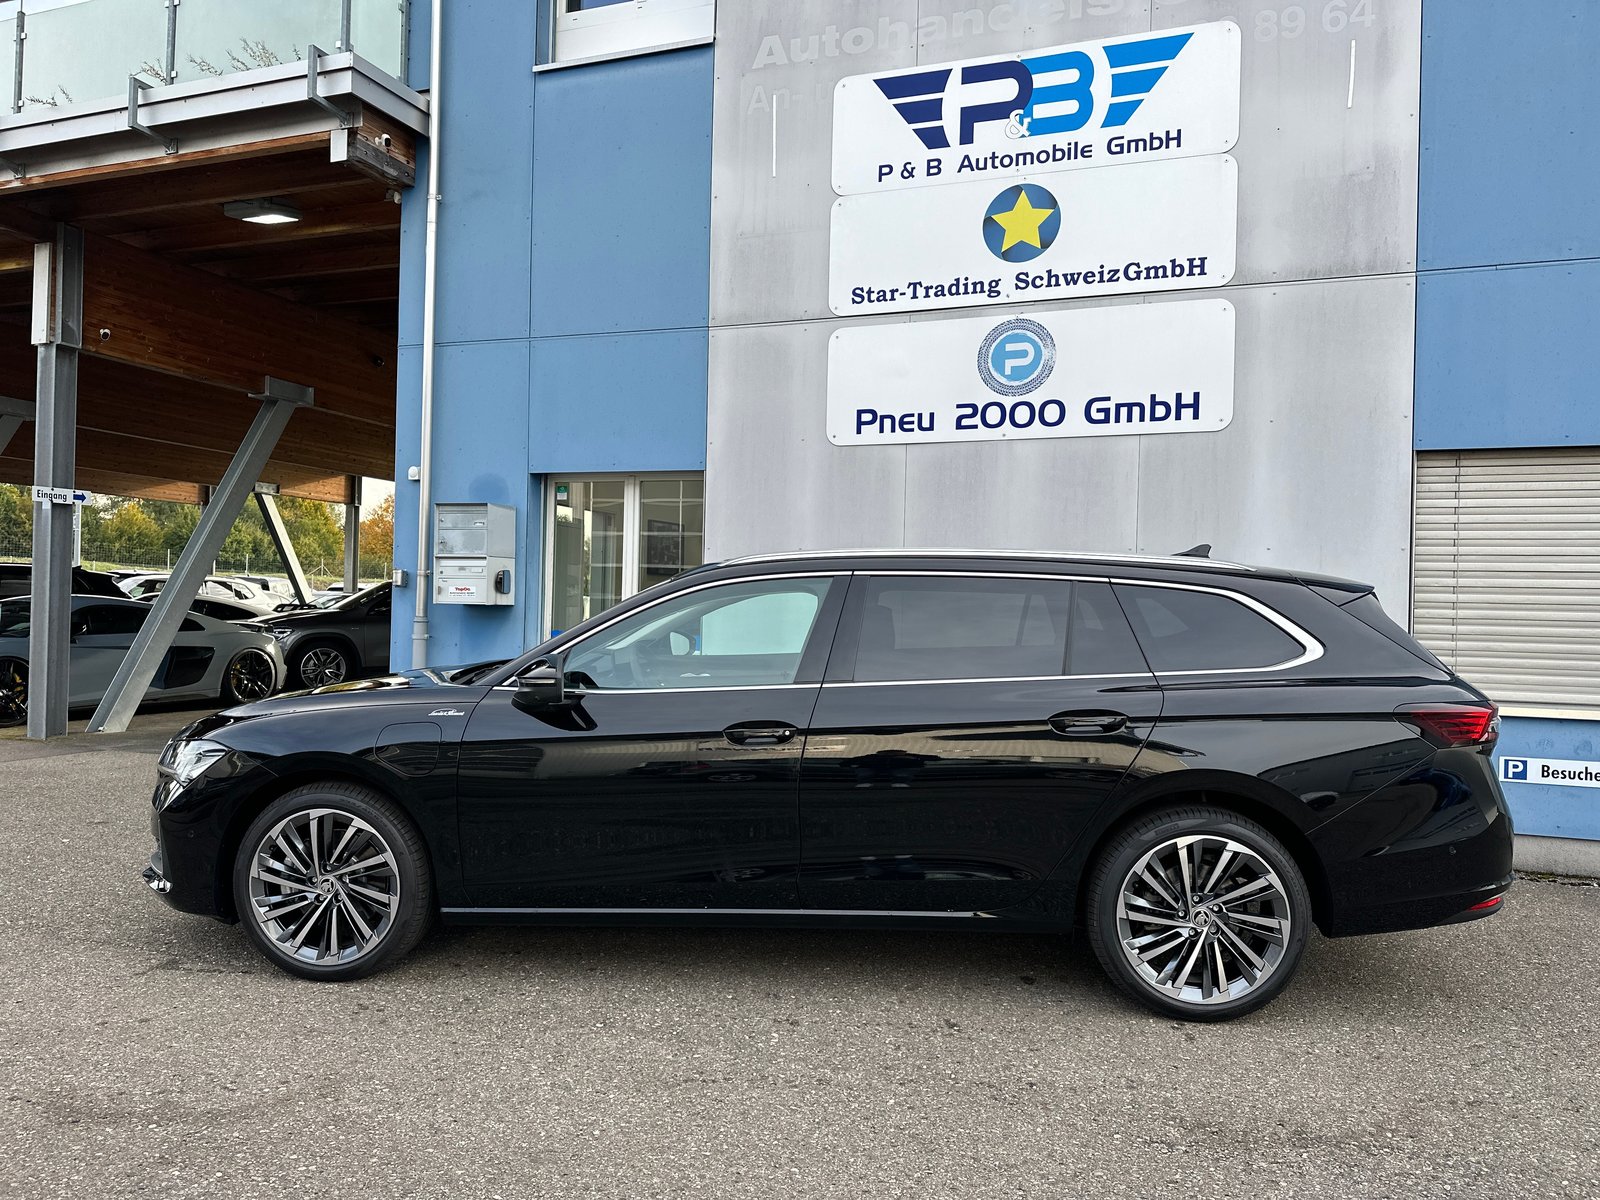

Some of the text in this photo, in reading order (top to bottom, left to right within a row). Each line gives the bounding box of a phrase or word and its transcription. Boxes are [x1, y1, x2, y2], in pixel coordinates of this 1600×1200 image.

[1254, 6, 1306, 43] 89
[877, 128, 1182, 183] P & B Automobile GmbH
[851, 275, 1002, 305] Star-Trading
[1004, 342, 1035, 376] P
[855, 391, 1201, 435] Pneu 2000 GmbH
[36, 489, 68, 503] Eingang
[1507, 760, 1600, 781] P Besuche
